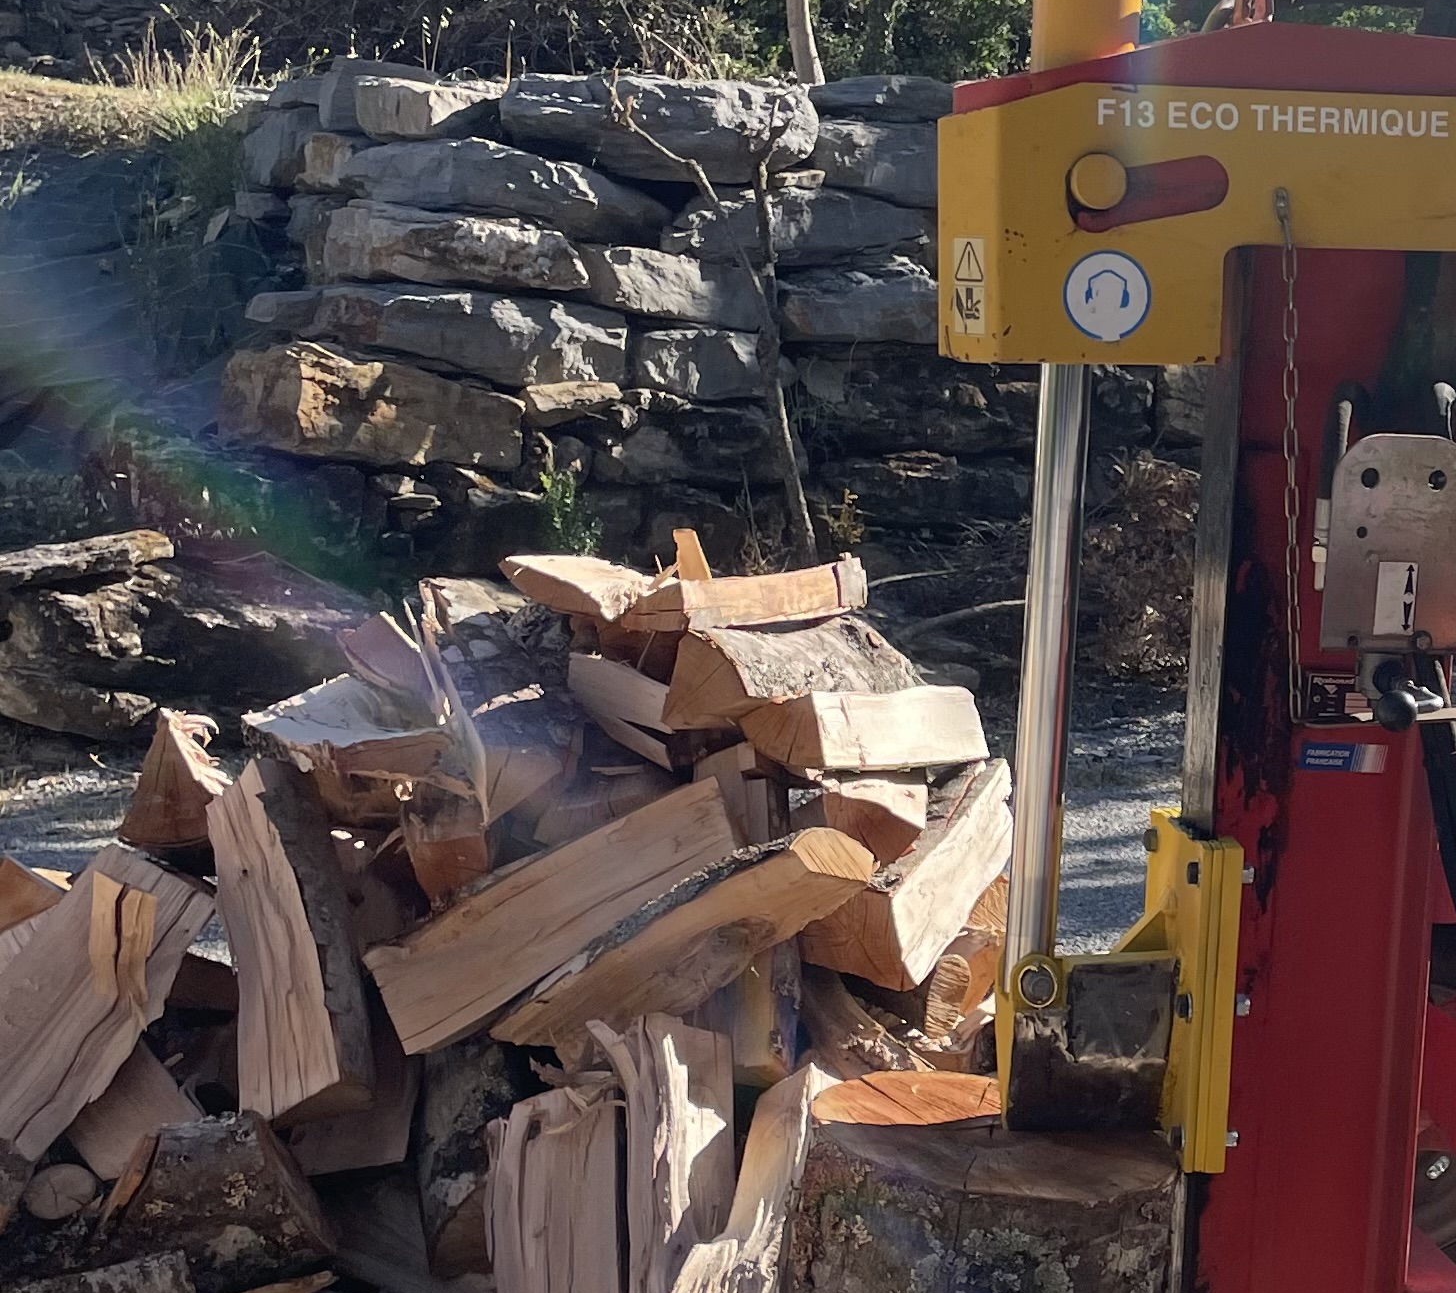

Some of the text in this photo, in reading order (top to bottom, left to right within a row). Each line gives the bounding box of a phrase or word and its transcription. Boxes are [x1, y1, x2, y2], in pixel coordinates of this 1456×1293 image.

[1097, 98, 1449, 138] F13 ECO THERMIQUE
